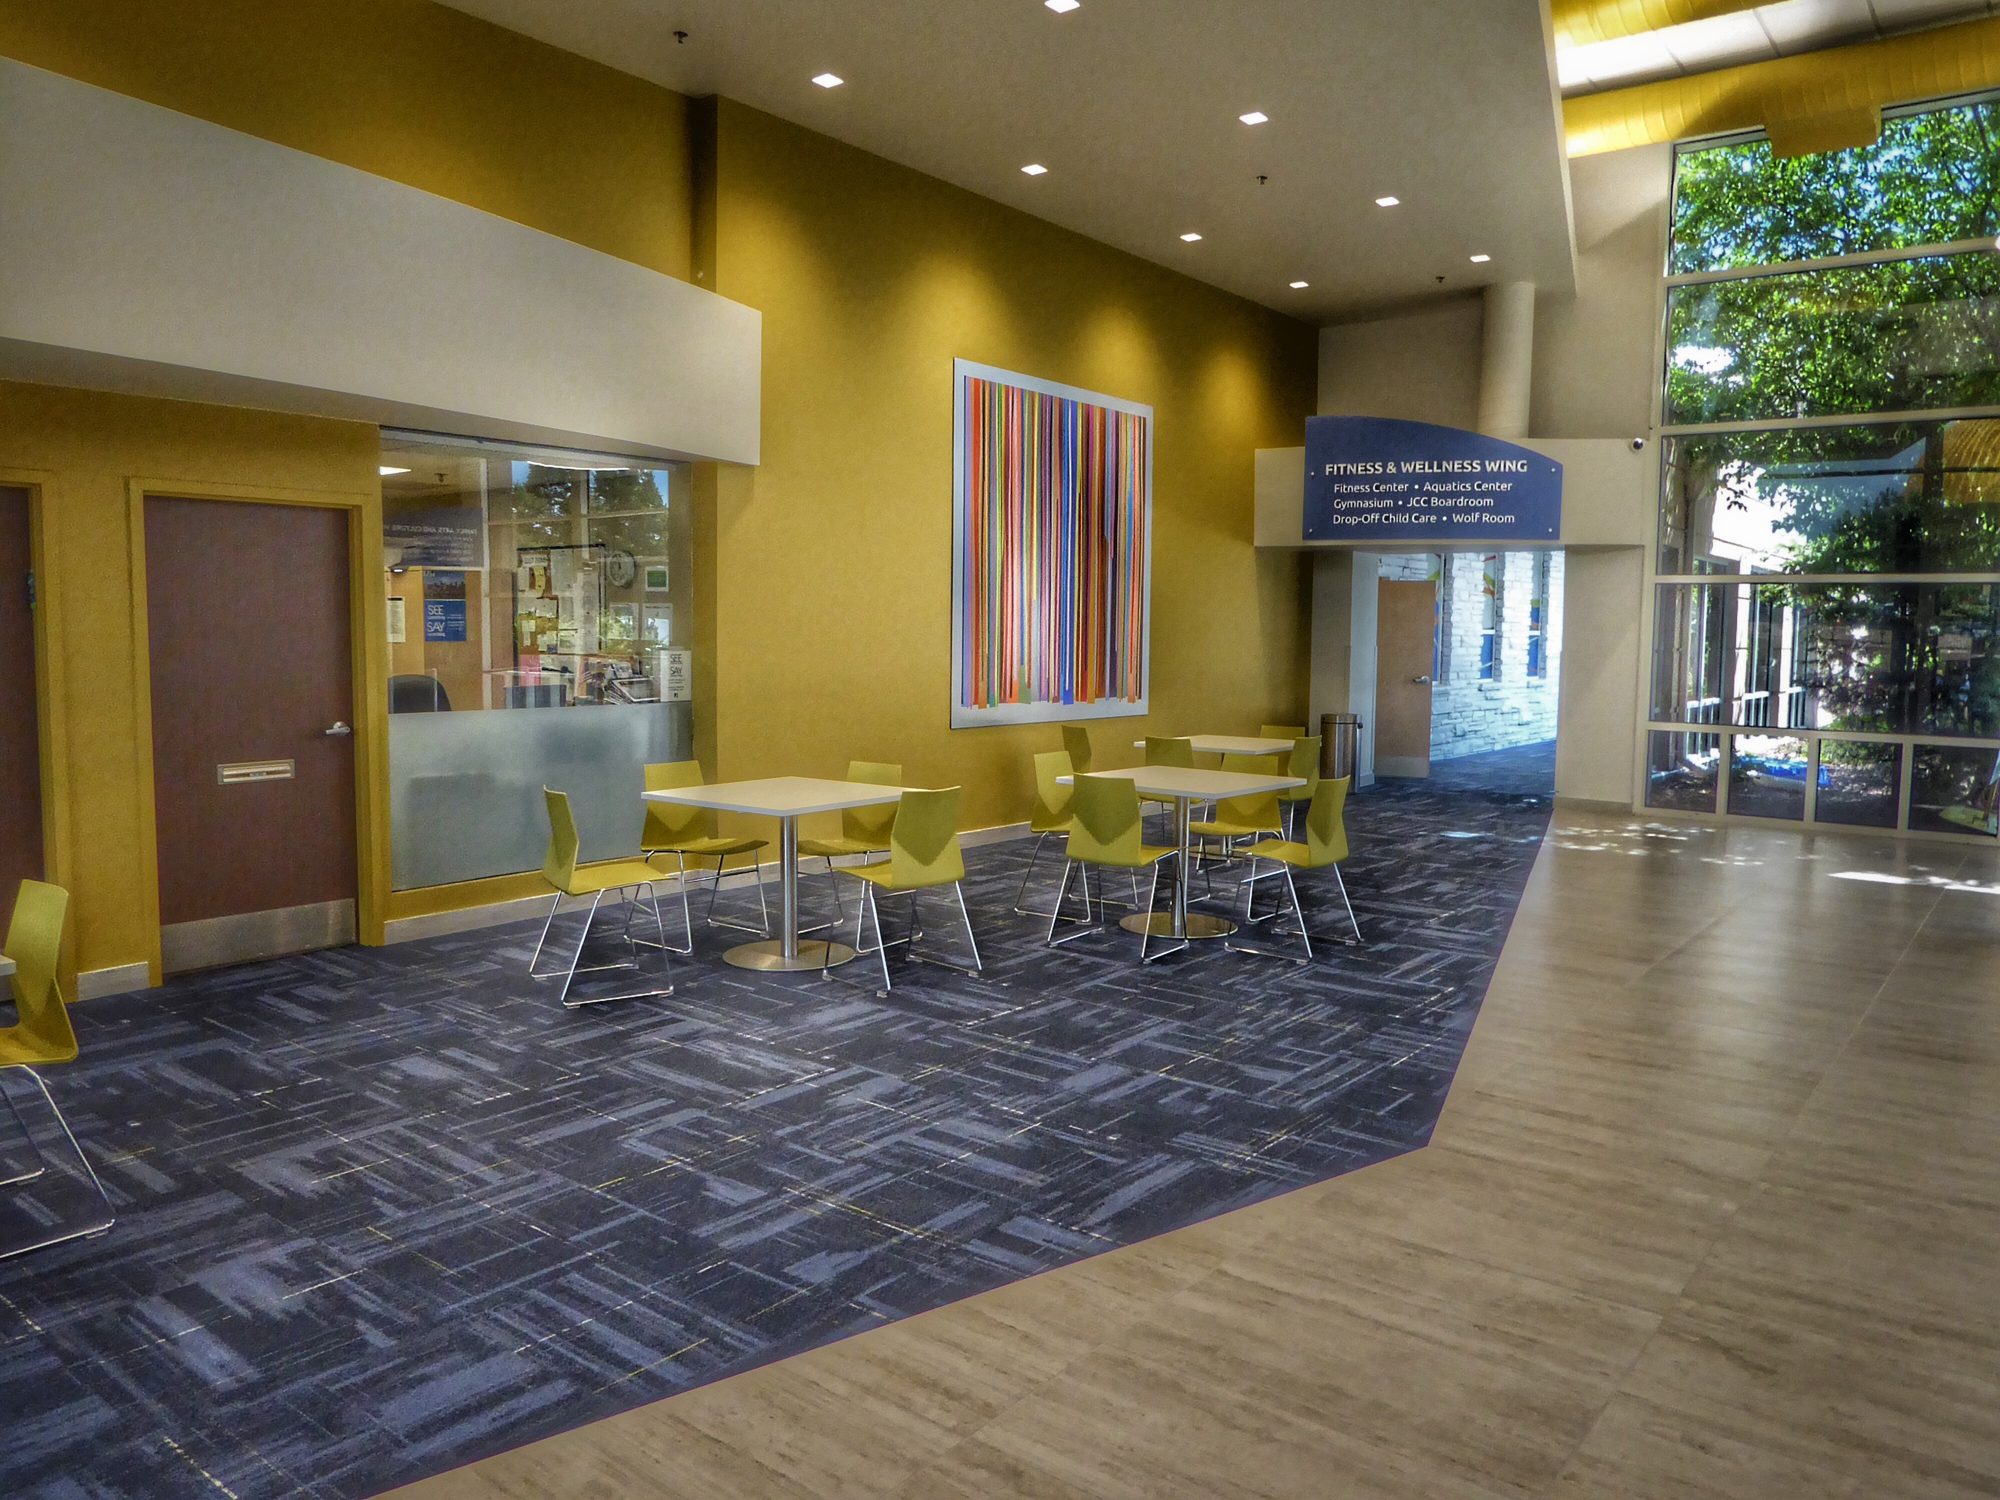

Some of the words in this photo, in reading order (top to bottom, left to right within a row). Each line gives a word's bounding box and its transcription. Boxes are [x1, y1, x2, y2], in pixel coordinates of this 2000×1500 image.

[1325, 462, 1383, 476] FITNESS
[1386, 461, 1397, 474] &
[1400, 460, 1481, 474] WELLNESS
[1485, 460, 1528, 473] WING
[1334, 483, 1370, 493] Fitness
[1372, 482, 1409, 492] Center
[1423, 481, 1472, 493] Aquatics
[1474, 481, 1513, 492] Center
[1333, 498, 1394, 511] Gymnasium
[1406, 497, 1428, 507] JCC
[1430, 496, 1494, 507] Boardroom
[1333, 513, 1380, 526] Drop-Off
[1381, 513, 1409, 524] Child
[1411, 513, 1437, 523] Care
[1452, 512, 1480, 523] Wolf
[1482, 513, 1515, 523] Room
[428, 604, 445, 616] SEE
[427, 622, 446, 633] SAY
[670, 653, 682, 663] SEE
[670, 666, 682, 675] SAY
